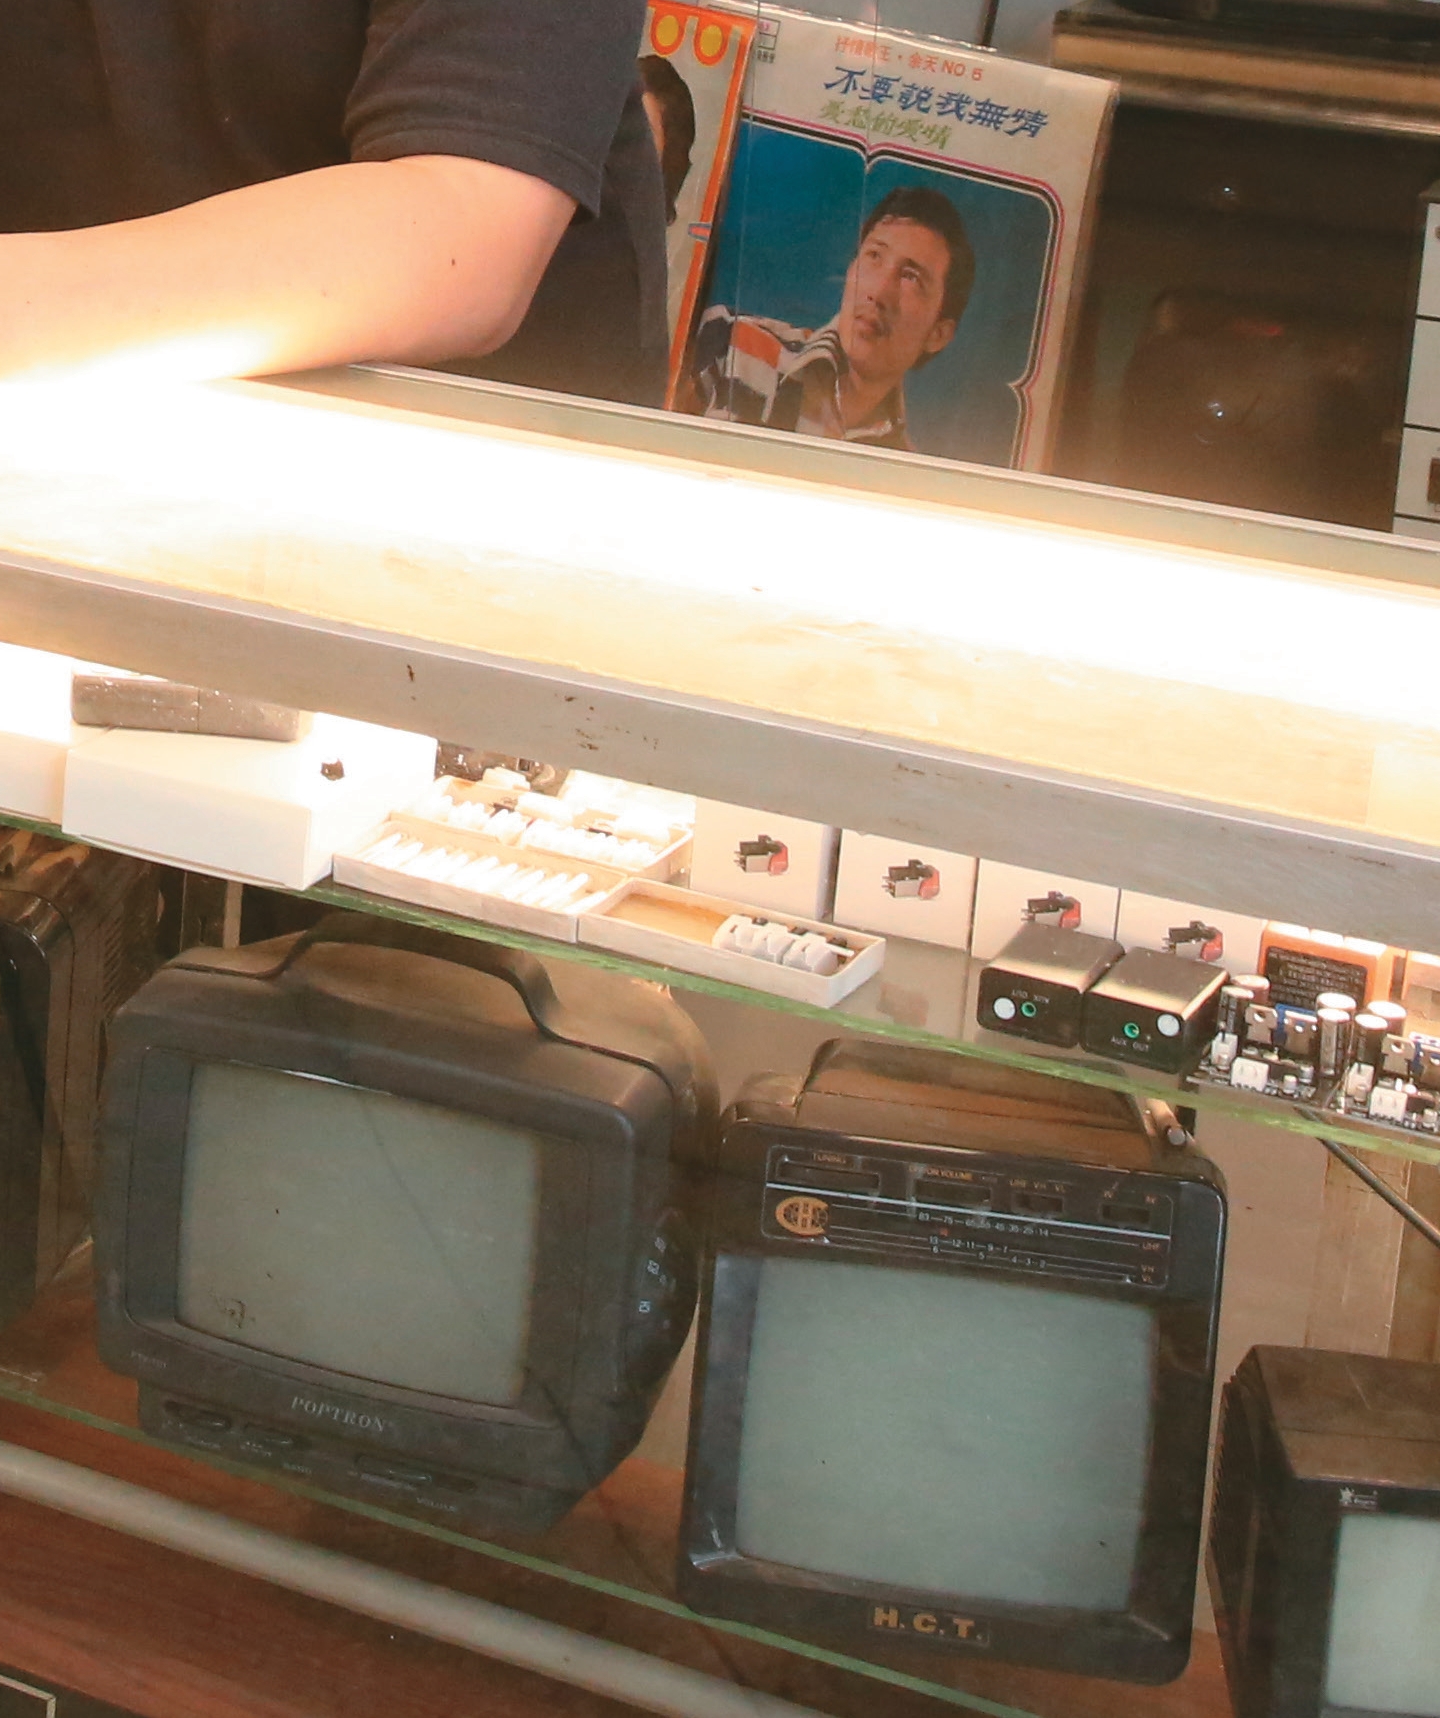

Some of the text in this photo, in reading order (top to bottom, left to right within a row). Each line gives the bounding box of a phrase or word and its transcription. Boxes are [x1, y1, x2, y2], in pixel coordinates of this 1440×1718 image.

[824, 65, 1049, 138] 不要說我無情
[1111, 1035, 1150, 1052] AUX OUT
[812, 1153, 847, 1166] TUNING
[940, 1167, 973, 1180] VOLUME
[290, 1395, 386, 1433] POPTRON
